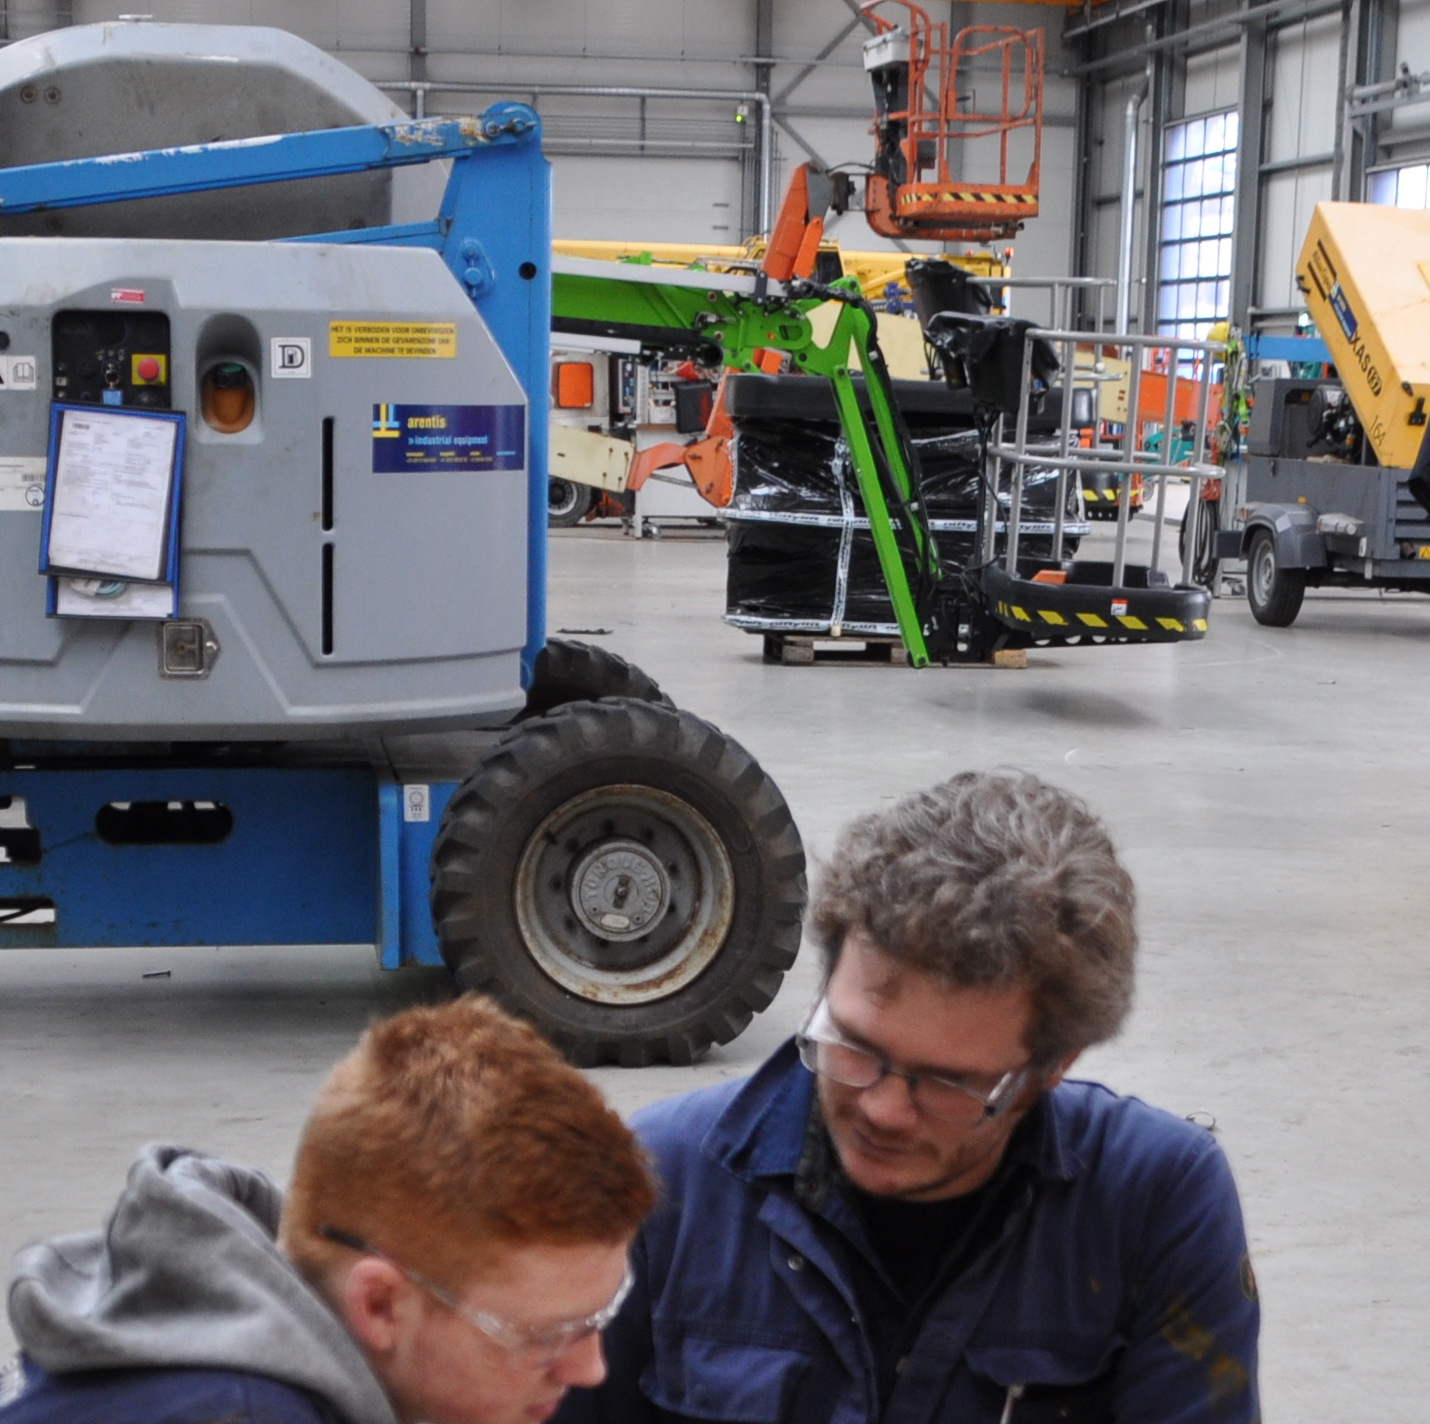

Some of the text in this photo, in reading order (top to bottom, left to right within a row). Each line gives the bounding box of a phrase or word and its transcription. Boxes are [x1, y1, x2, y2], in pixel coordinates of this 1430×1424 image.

[1351, 331, 1371, 373] XAS
[407, 415, 447, 429] arentis
[414, 435, 489, 447] industrial equipment
